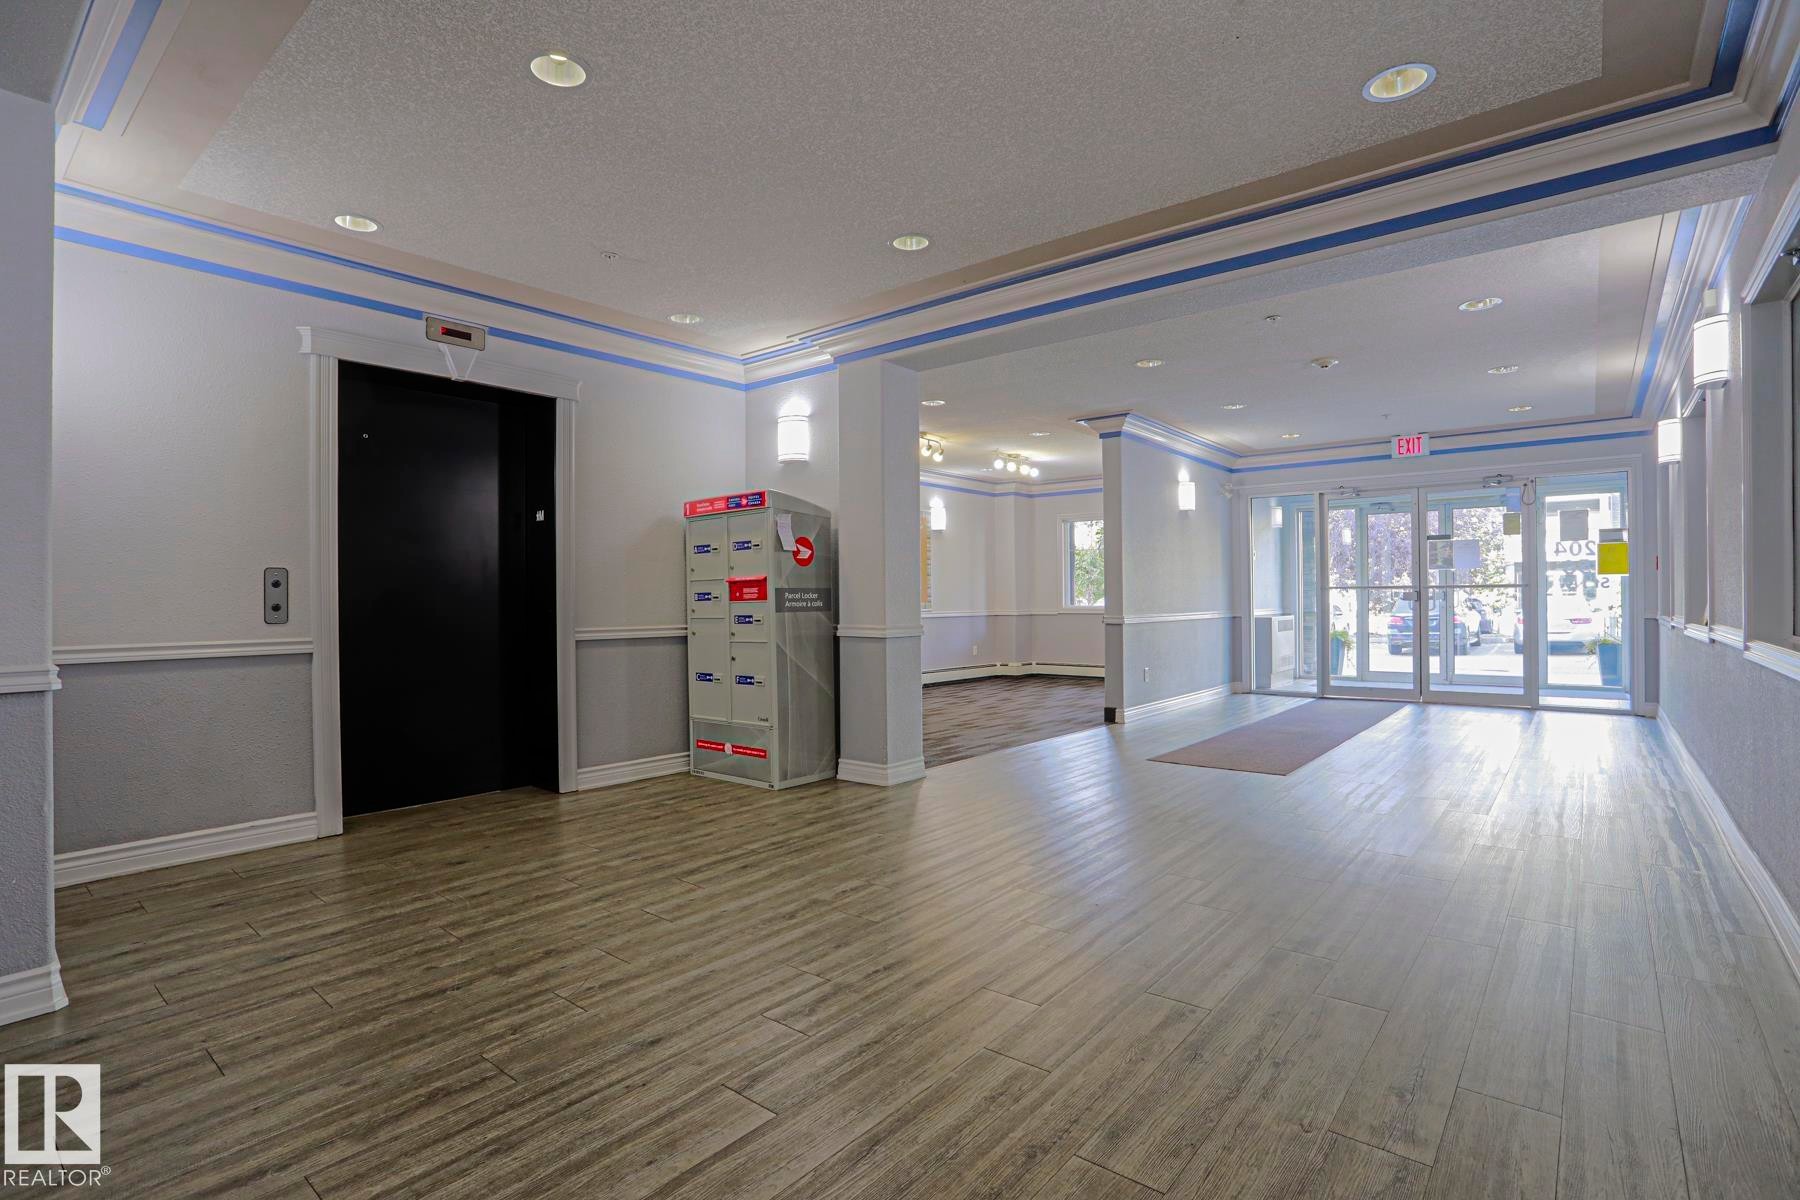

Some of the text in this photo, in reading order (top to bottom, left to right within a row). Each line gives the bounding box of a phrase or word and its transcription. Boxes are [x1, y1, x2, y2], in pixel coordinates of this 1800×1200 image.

[1397, 436, 1422, 455] EXIT
[784, 592, 801, 600] Parcel
[784, 600, 807, 608] Armoire
